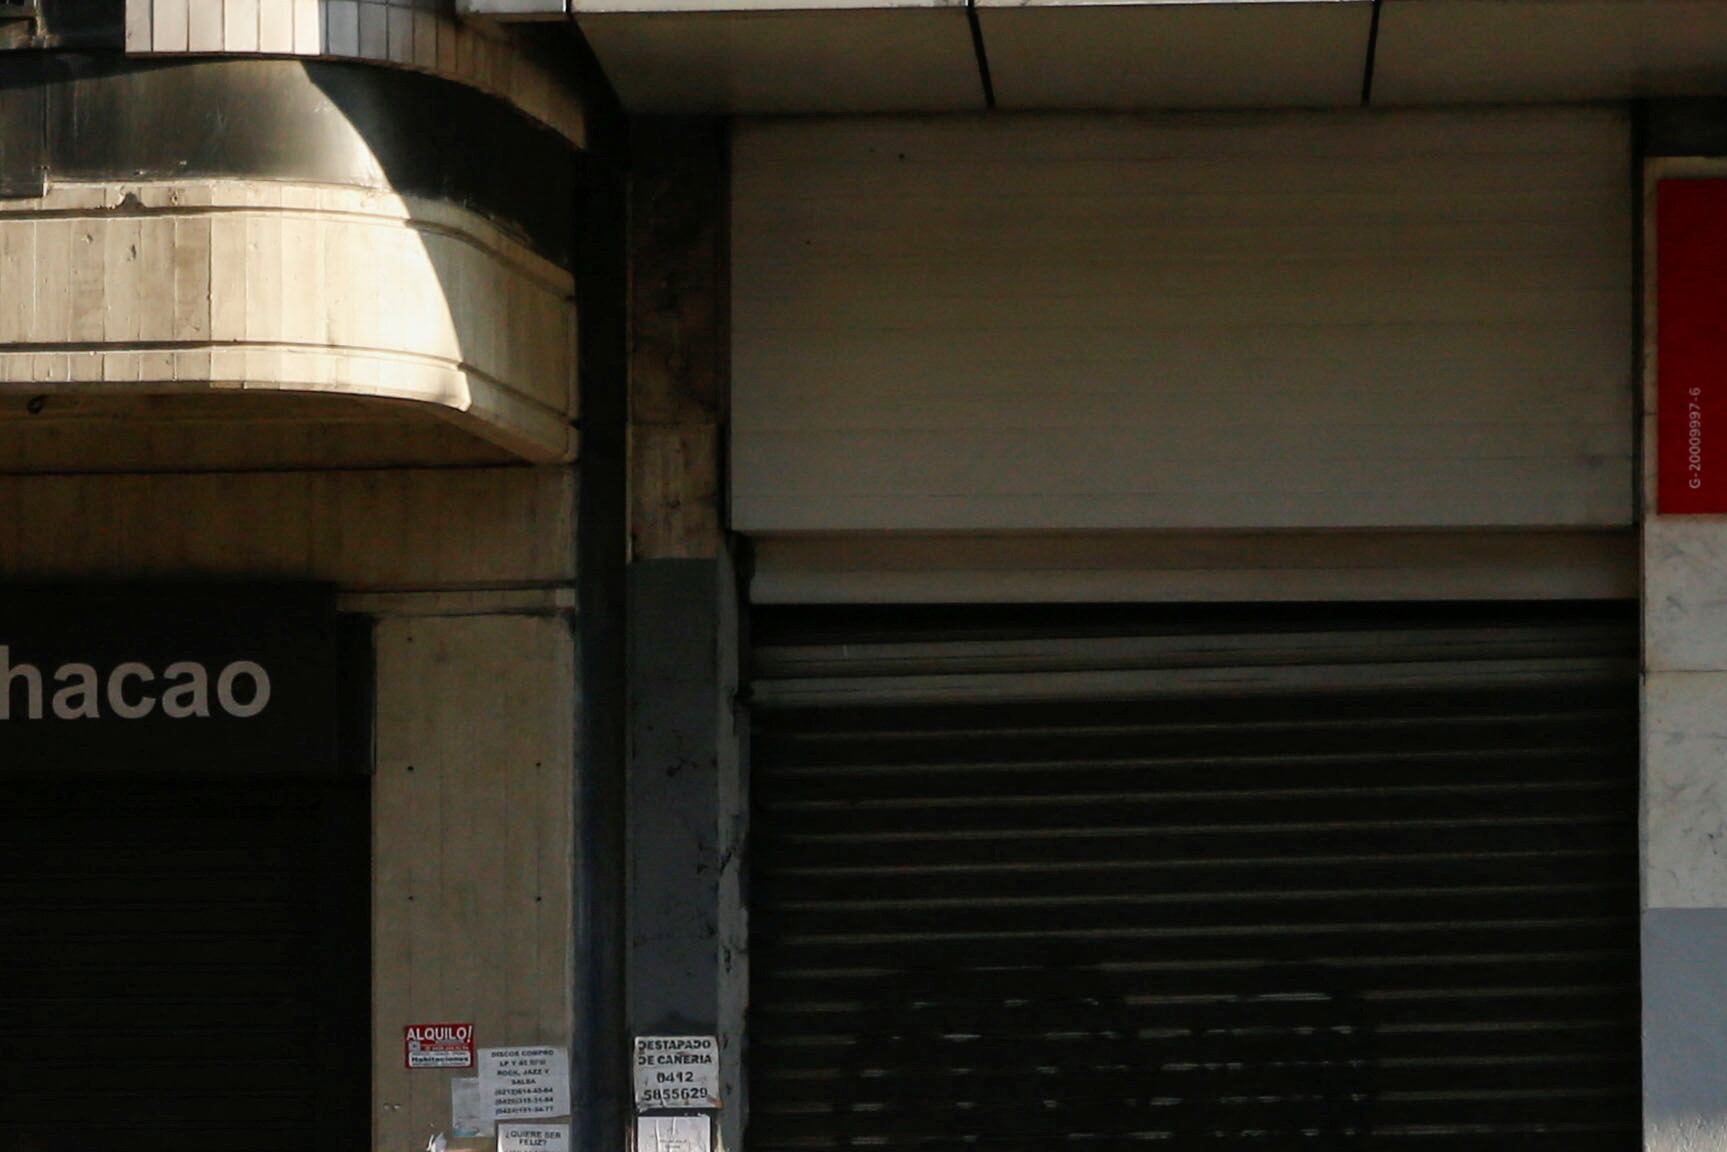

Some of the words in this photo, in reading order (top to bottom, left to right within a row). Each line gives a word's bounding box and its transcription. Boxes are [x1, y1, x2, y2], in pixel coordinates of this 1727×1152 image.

[1688, 386, 1702, 489] G-20009997-6
[406, 1025, 472, 1043] ALQUILO!
[638, 1040, 711, 1050] DESTAPADO
[657, 1071, 694, 1083] 0412
